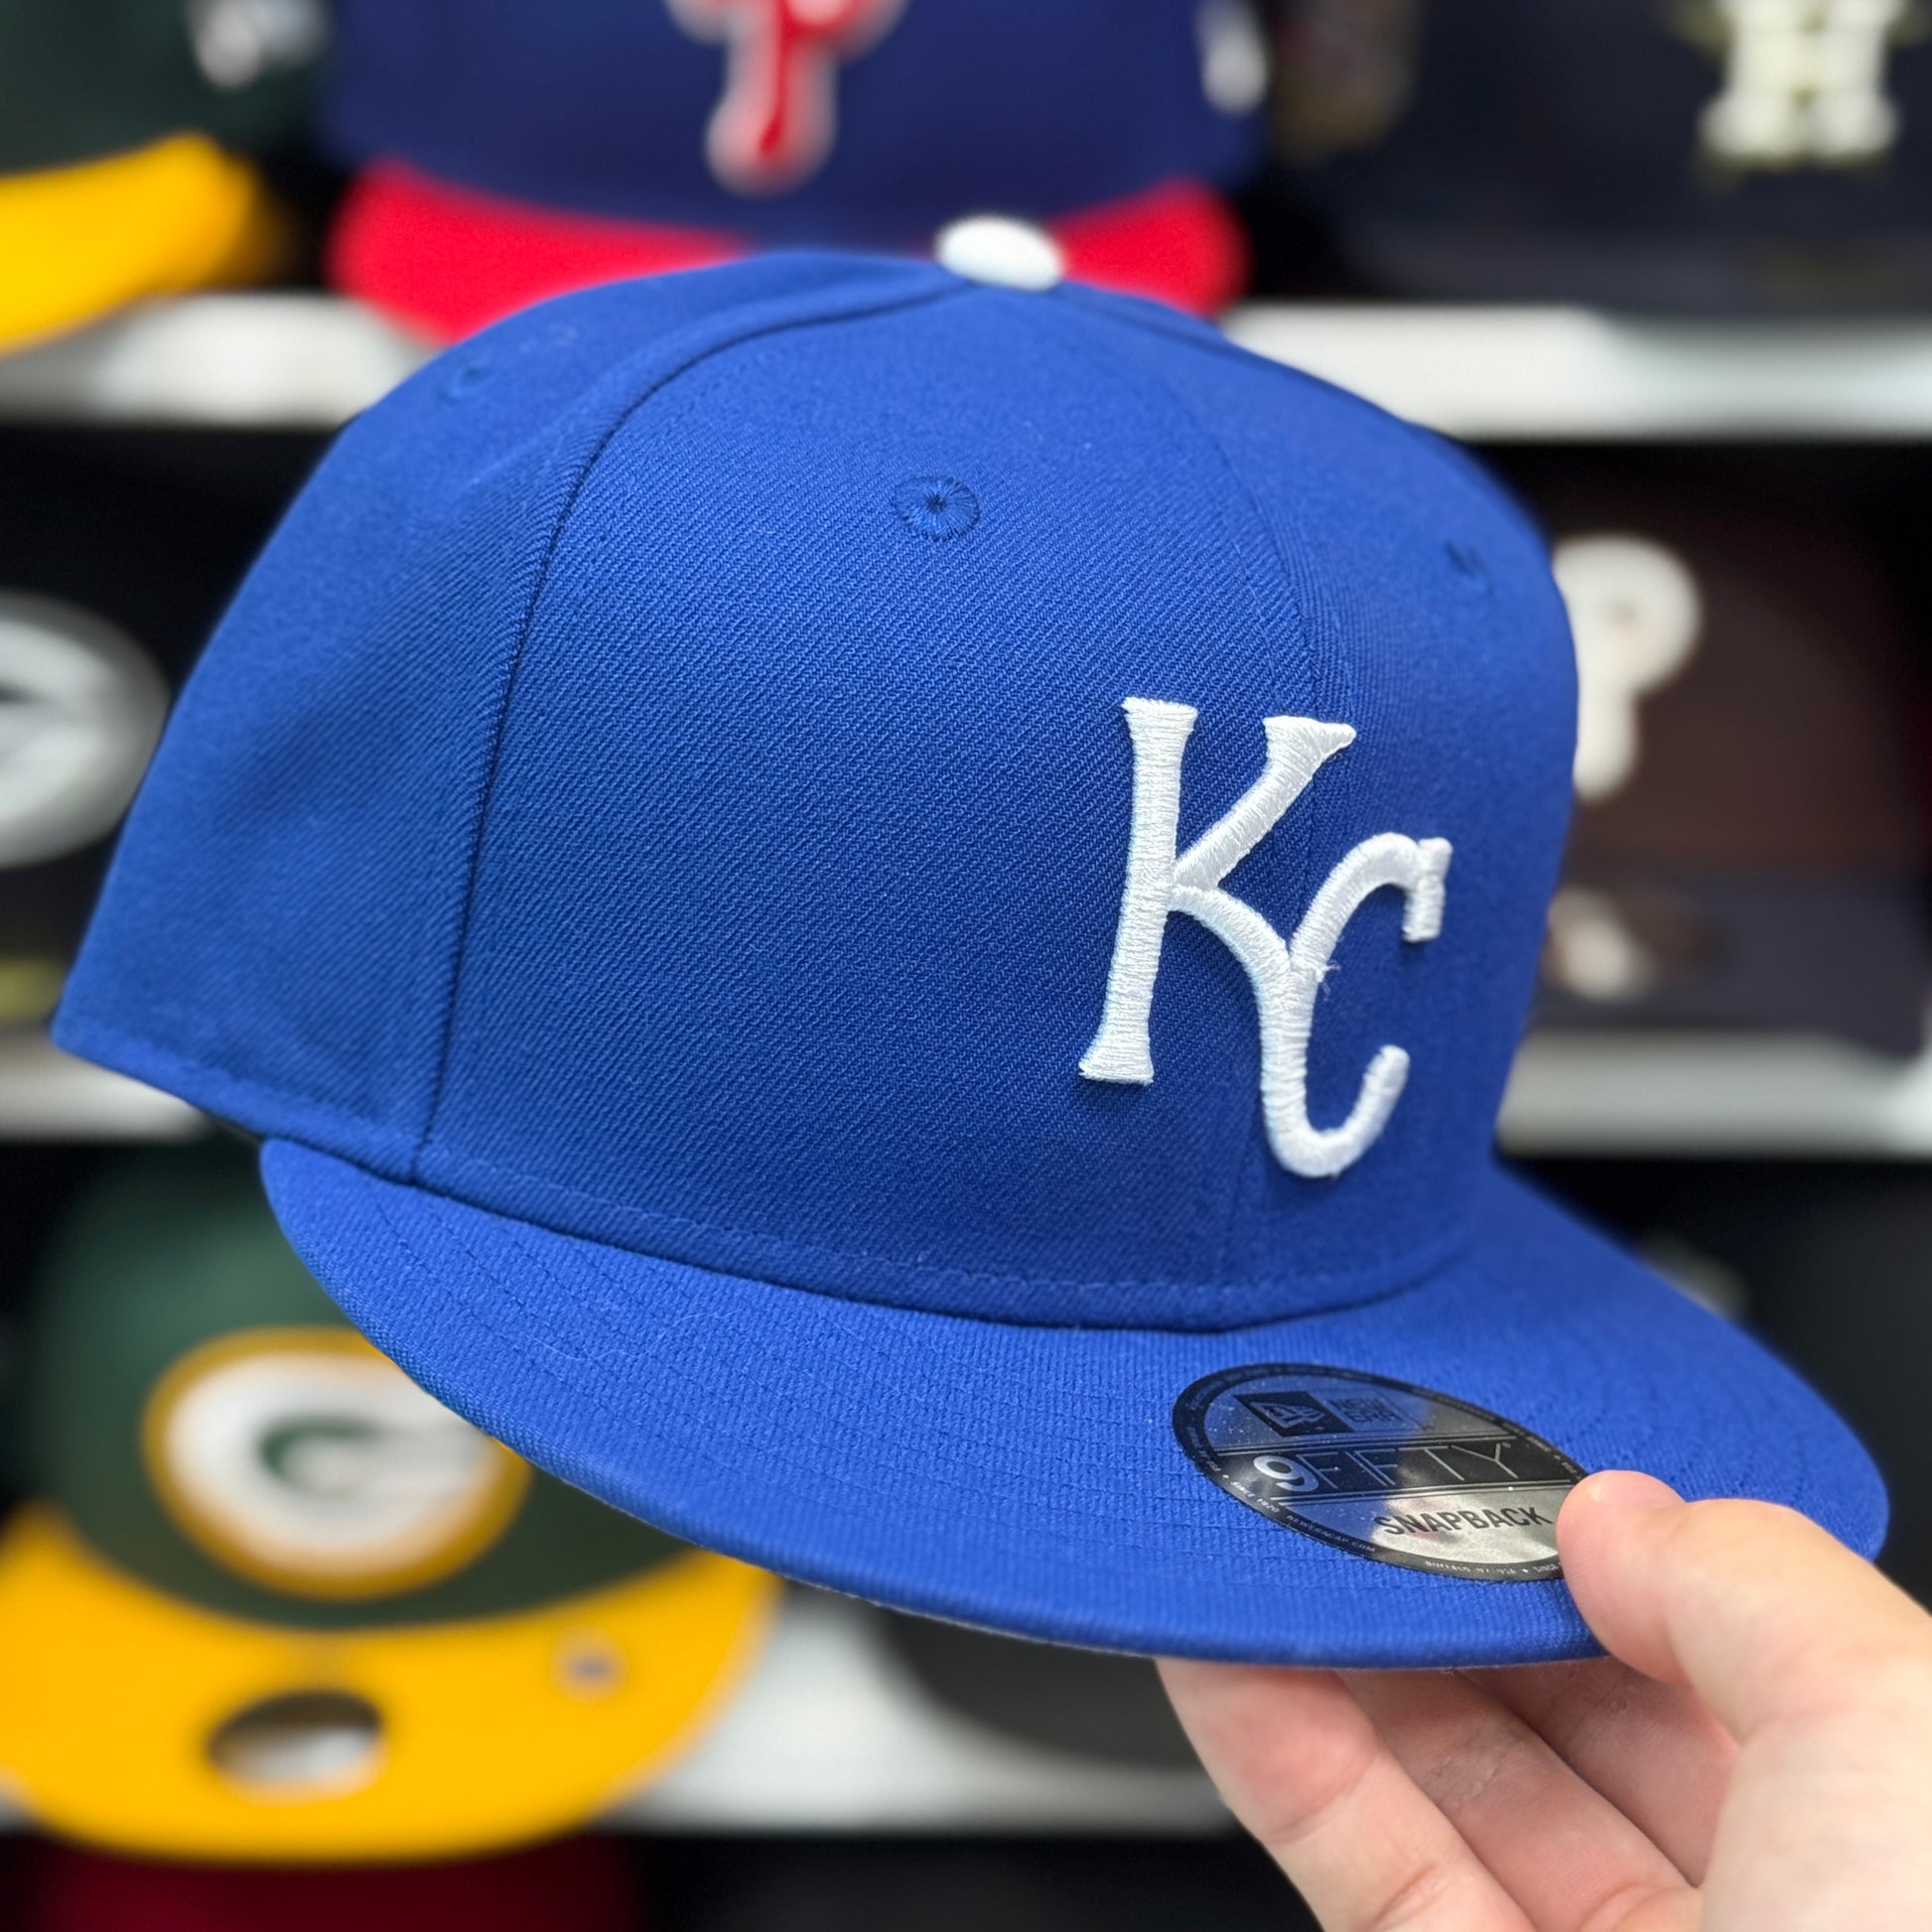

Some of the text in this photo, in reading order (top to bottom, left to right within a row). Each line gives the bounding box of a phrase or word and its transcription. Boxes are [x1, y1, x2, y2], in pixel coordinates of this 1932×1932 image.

[1327, 1397, 1388, 1411] NEW
[1343, 1409, 1404, 1423] ERA
[1373, 1506, 1554, 1536] SNAPBACK
